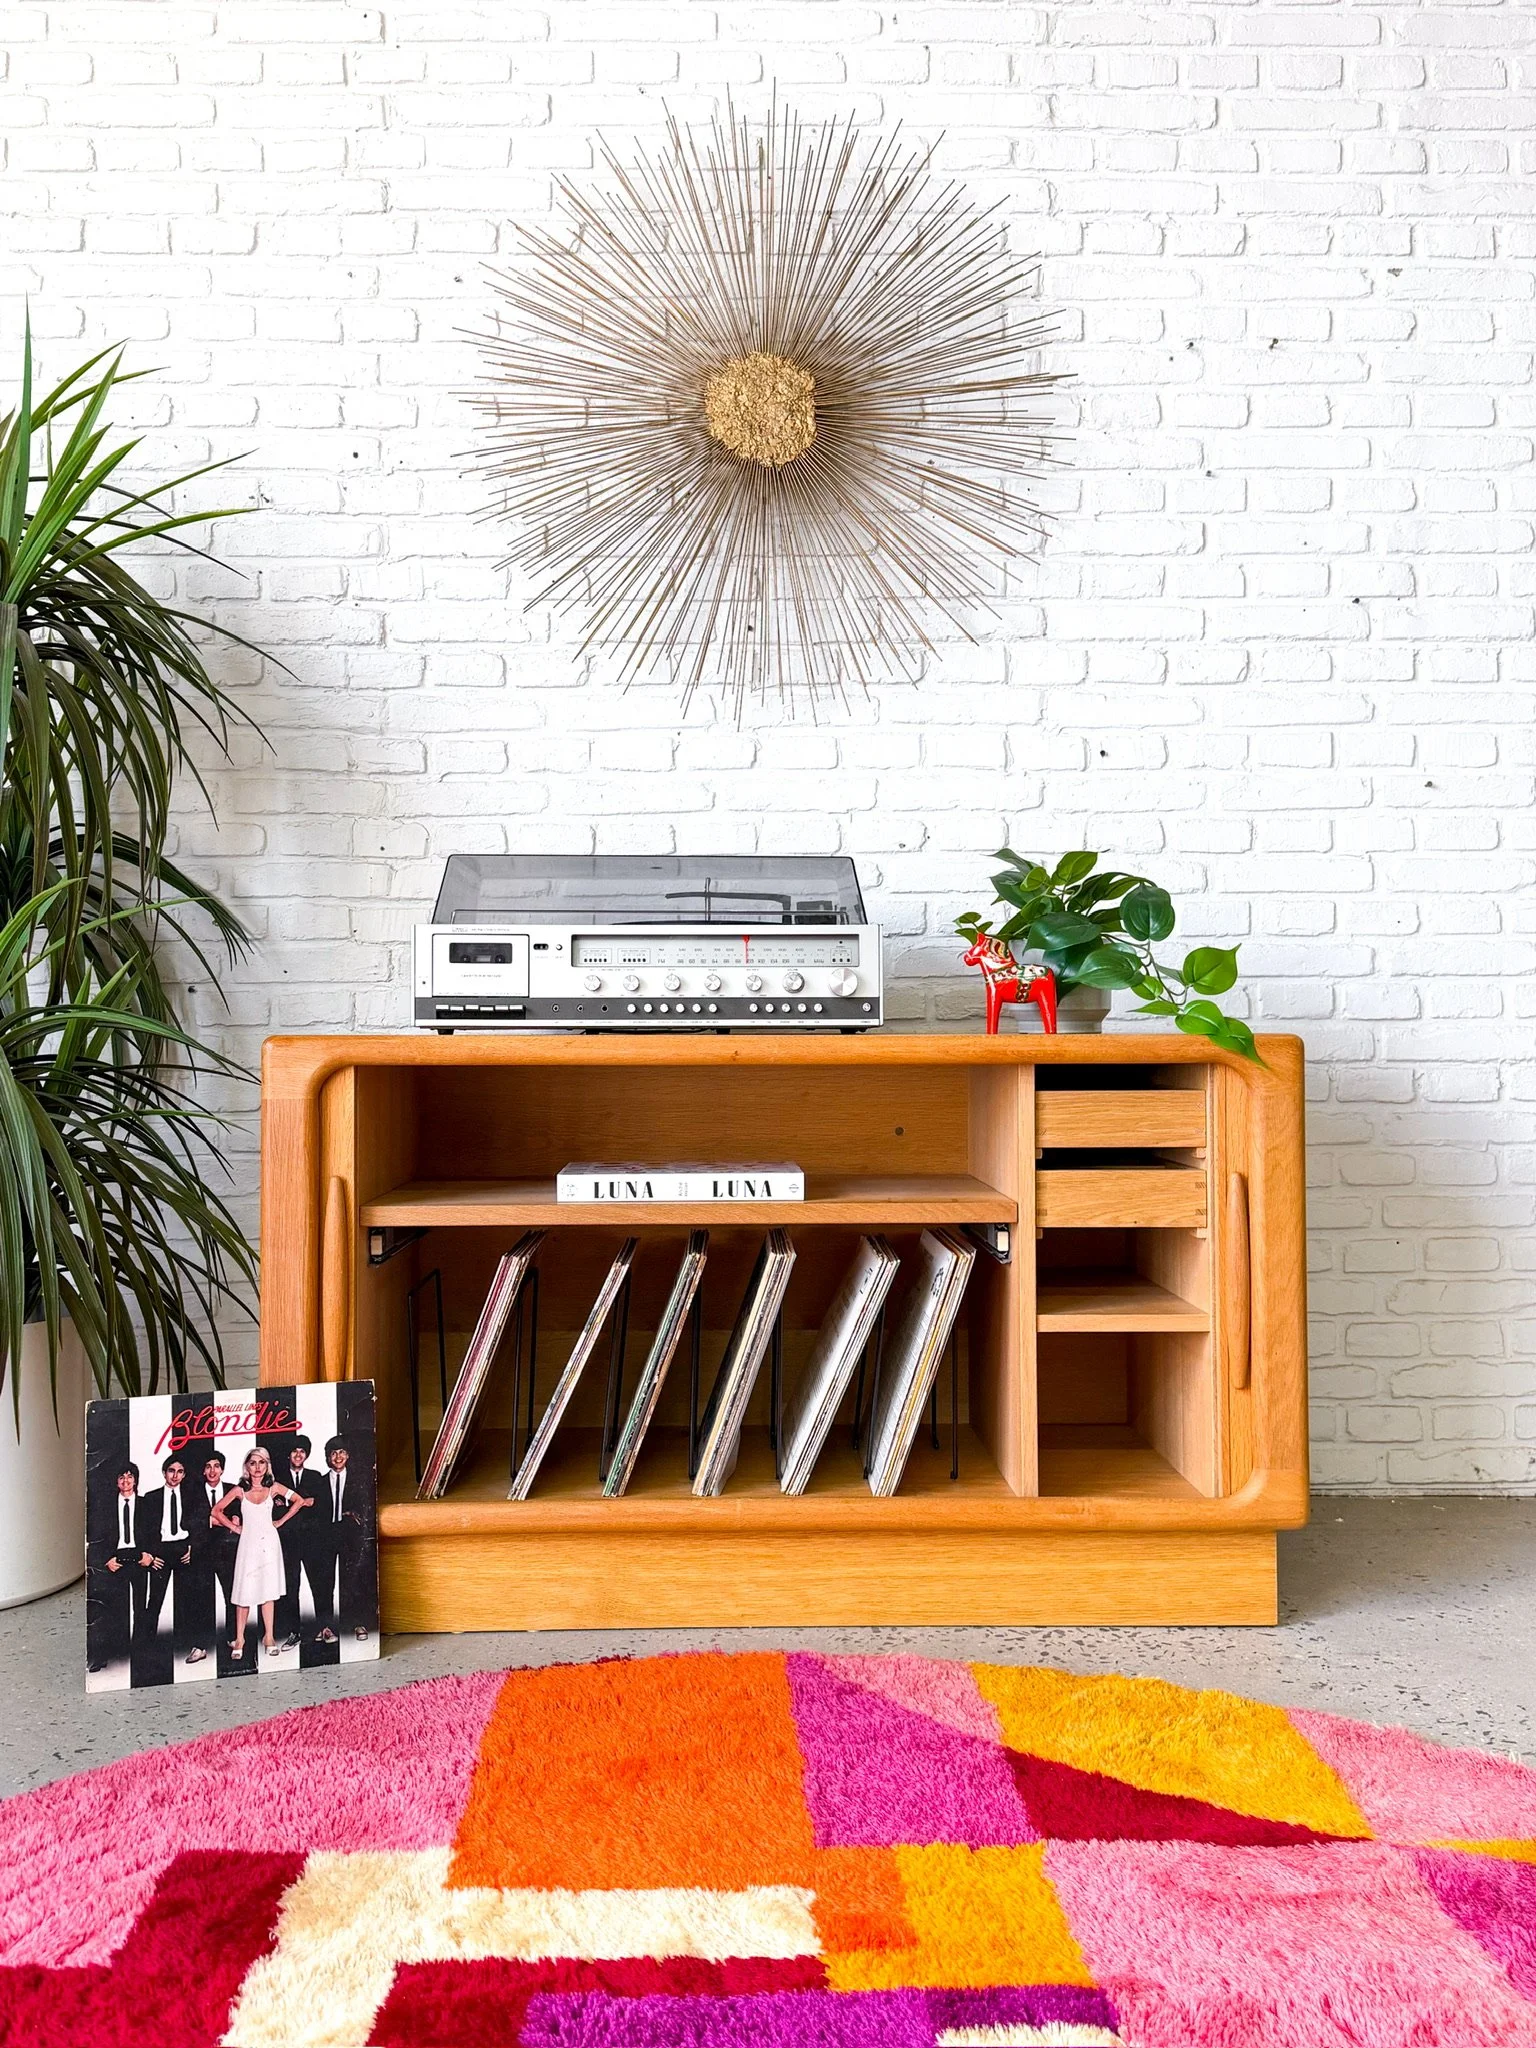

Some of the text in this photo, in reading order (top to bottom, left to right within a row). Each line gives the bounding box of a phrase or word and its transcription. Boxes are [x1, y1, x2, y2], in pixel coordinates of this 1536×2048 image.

[593, 1181, 654, 1199] LUNA
[712, 1180, 773, 1198] LUNA
[154, 1400, 303, 1455] Blondie
